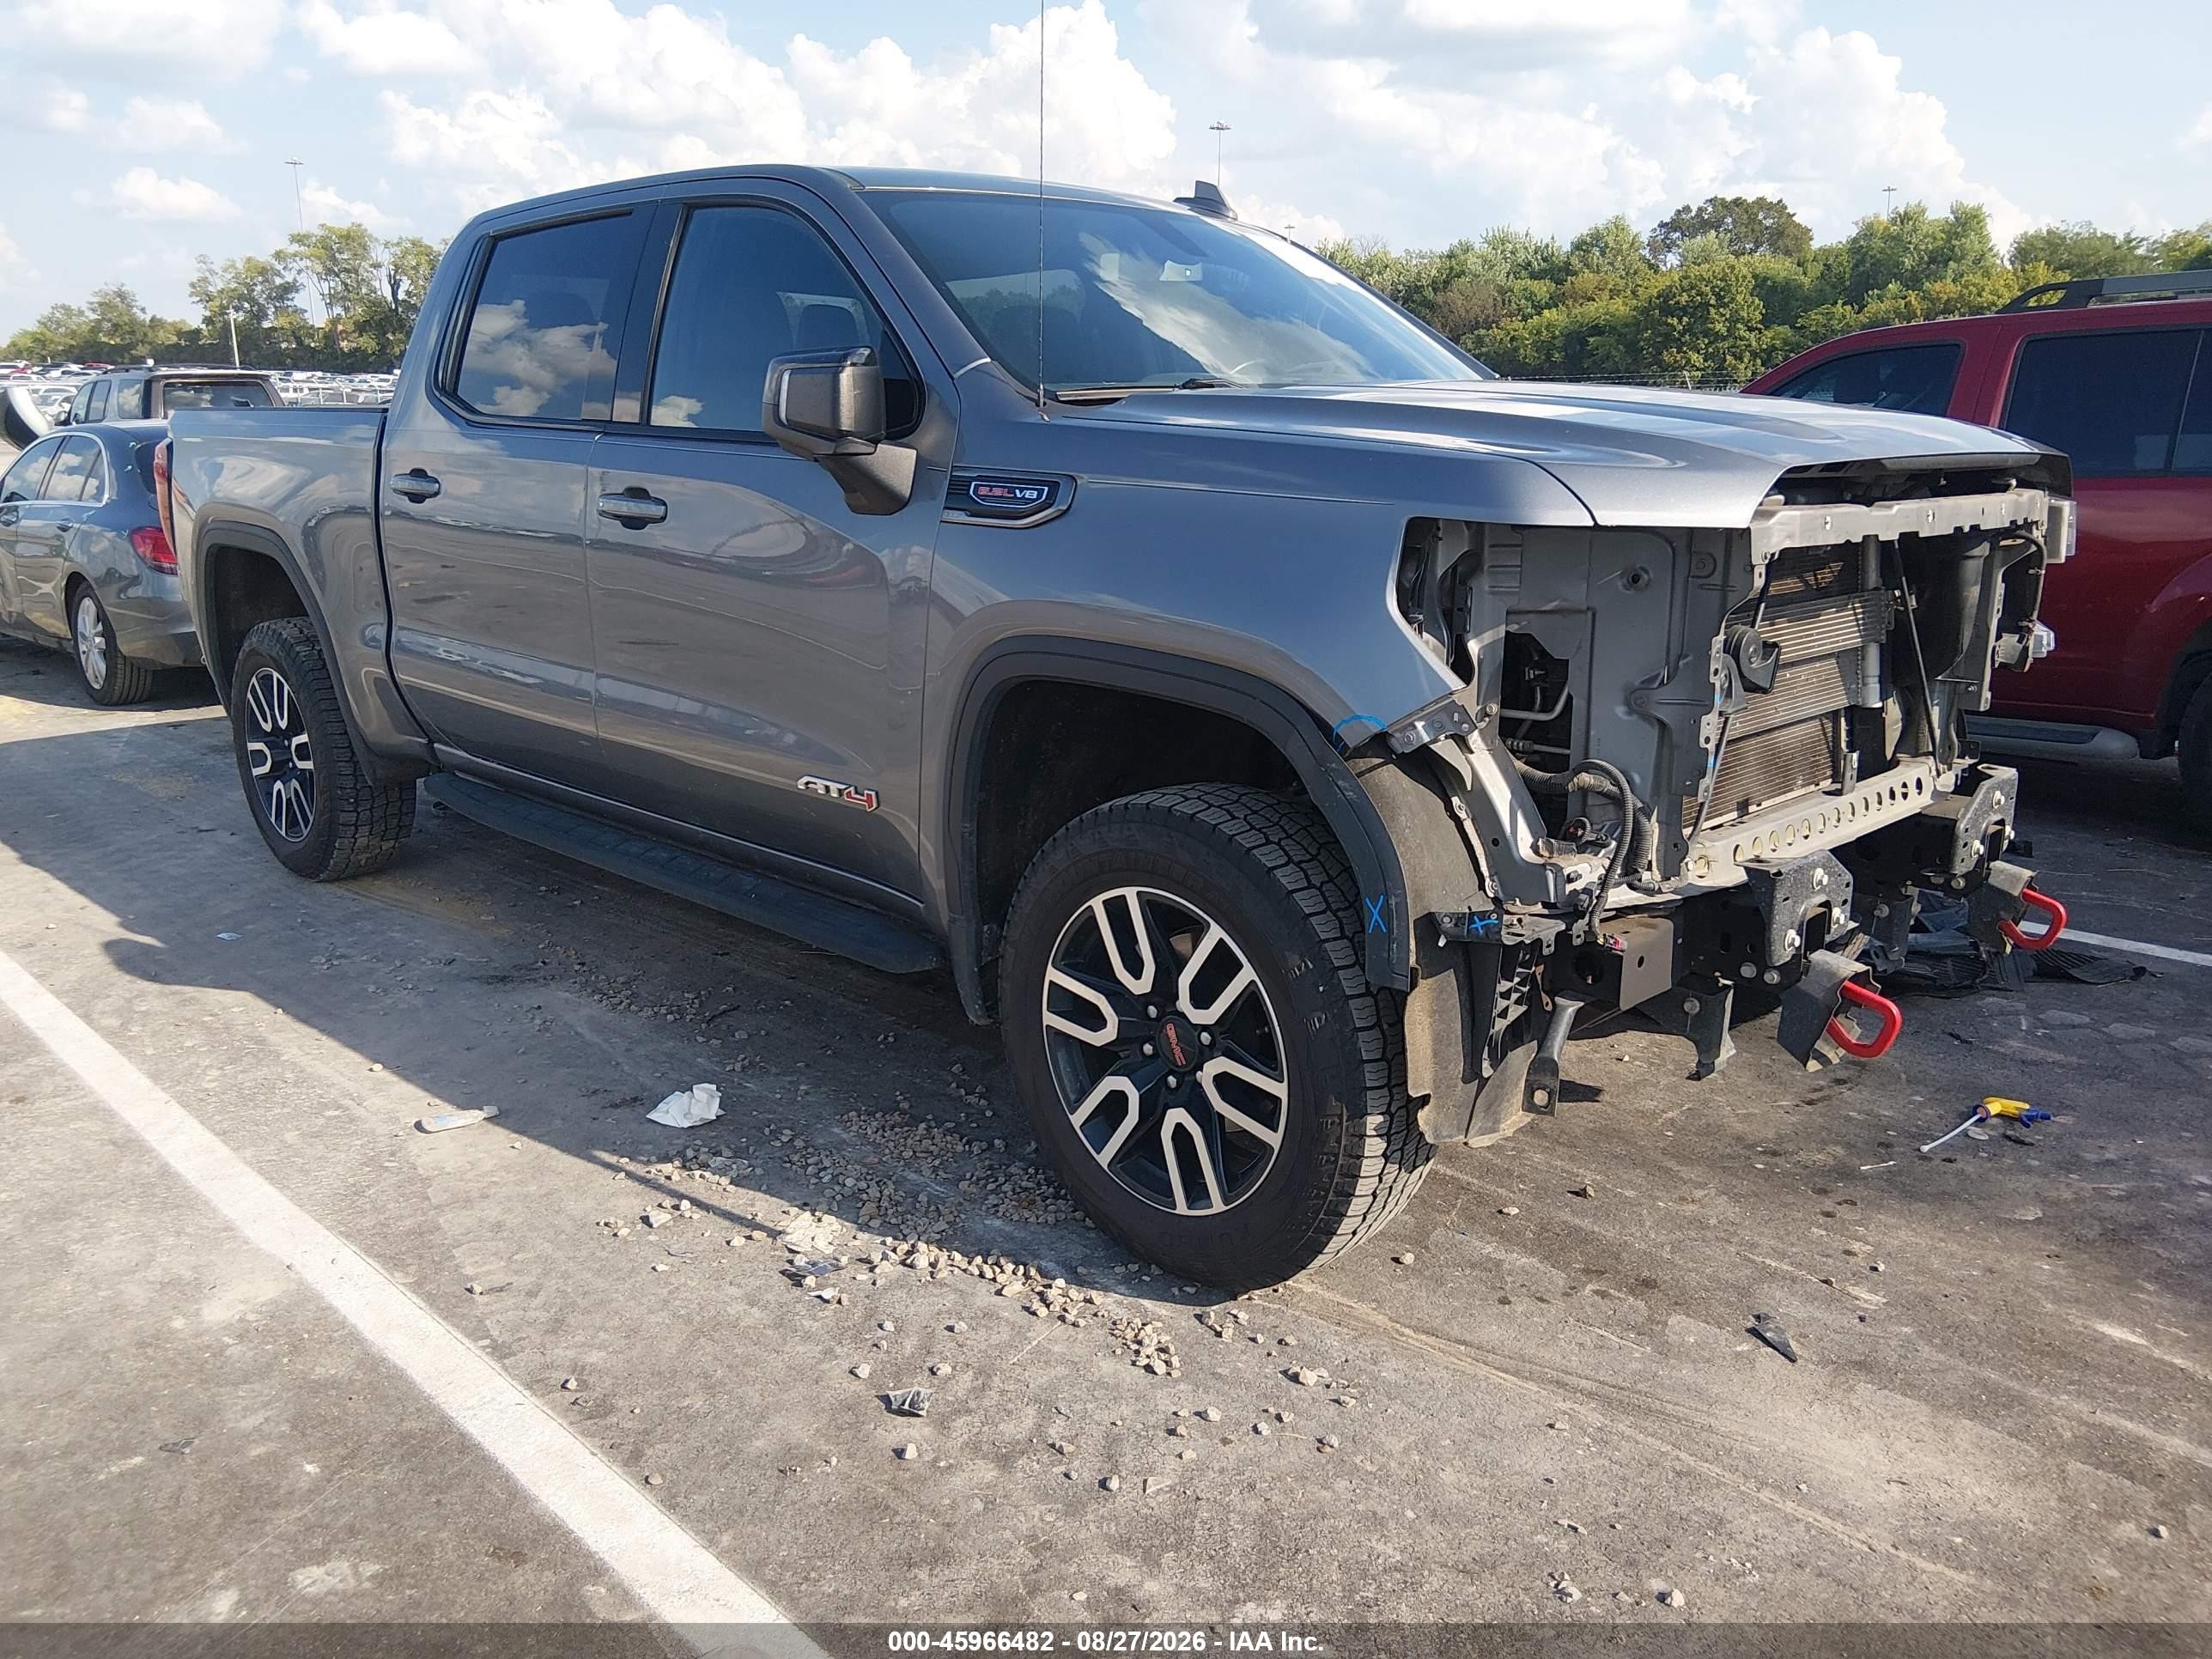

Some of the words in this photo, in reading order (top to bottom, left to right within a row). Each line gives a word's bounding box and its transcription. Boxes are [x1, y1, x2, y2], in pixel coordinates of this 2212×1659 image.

[1015, 489, 1038, 499] V8
[797, 775, 878, 811] AT4
[1166, 1023, 1188, 1066] GMC
